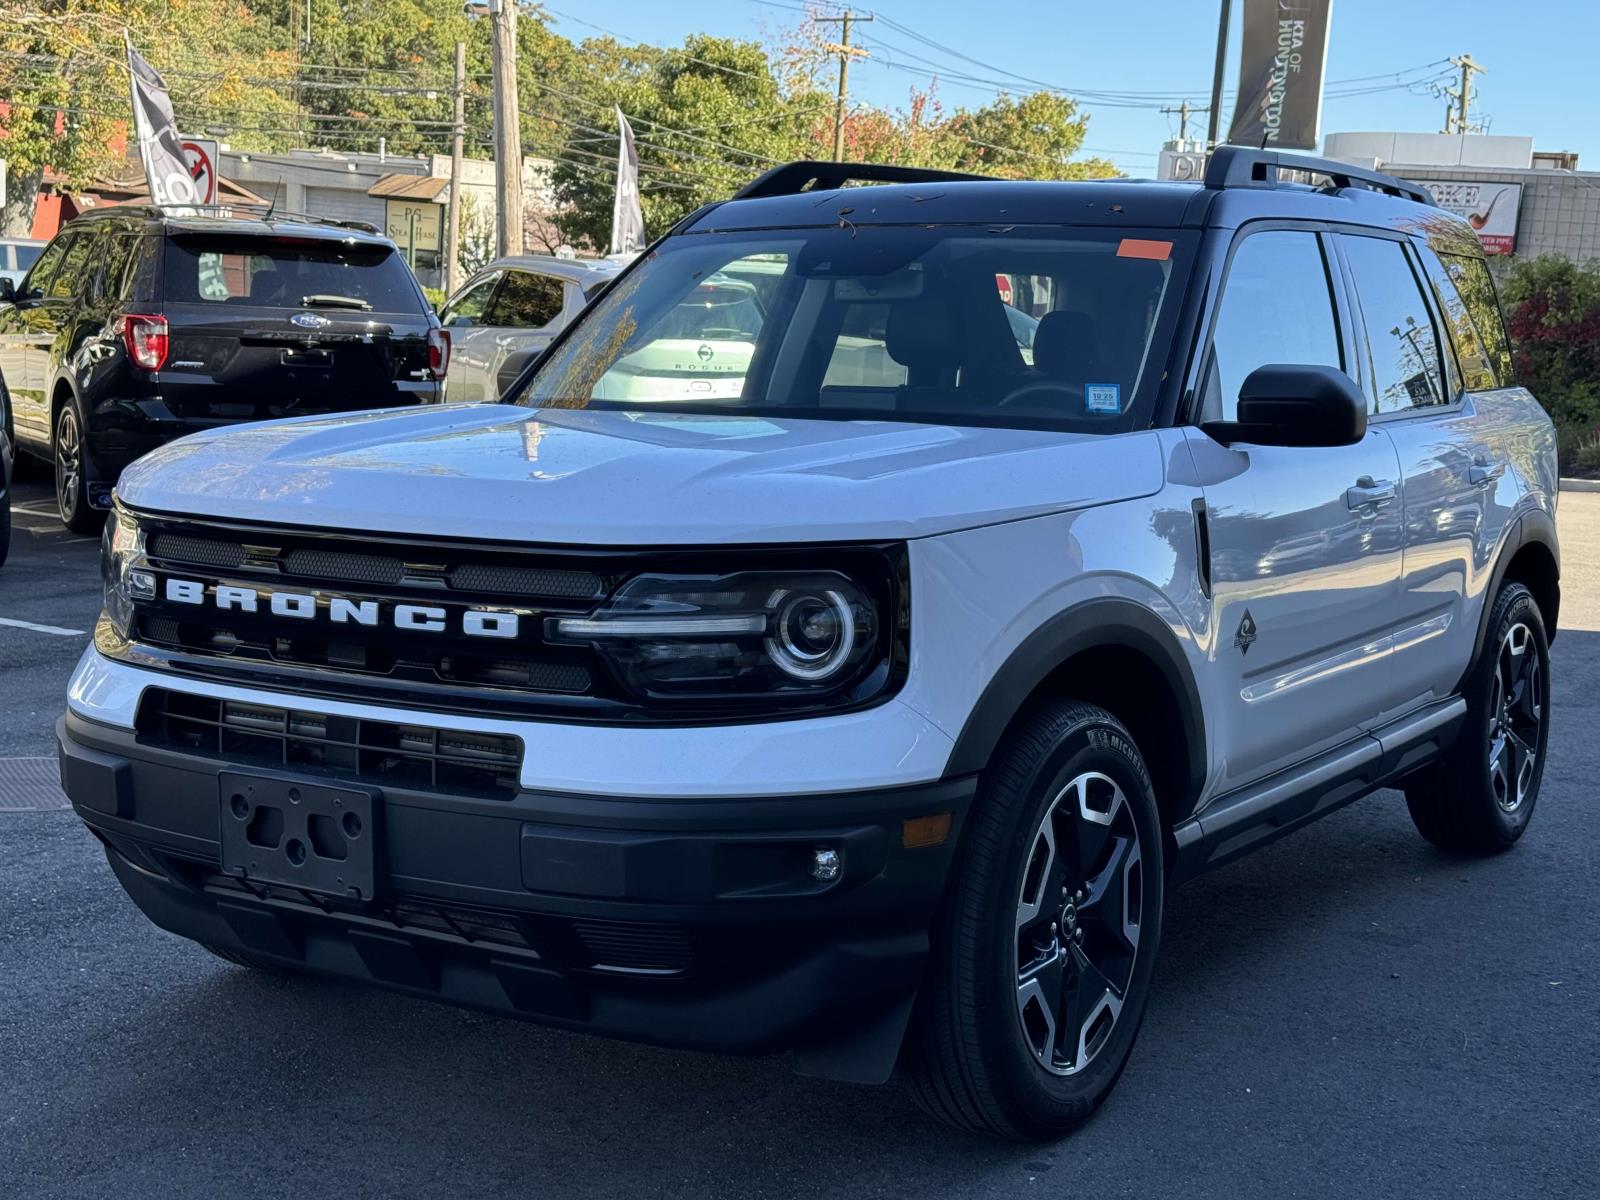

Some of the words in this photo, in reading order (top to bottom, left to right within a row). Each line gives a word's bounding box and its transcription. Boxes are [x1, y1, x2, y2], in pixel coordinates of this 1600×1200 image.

[1292, 20, 1305, 49] KIA
[1289, 52, 1302, 73] OF
[389, 224, 408, 239] STEA
[675, 363, 733, 371] ROGUE
[166, 578, 518, 638] BRONCO
